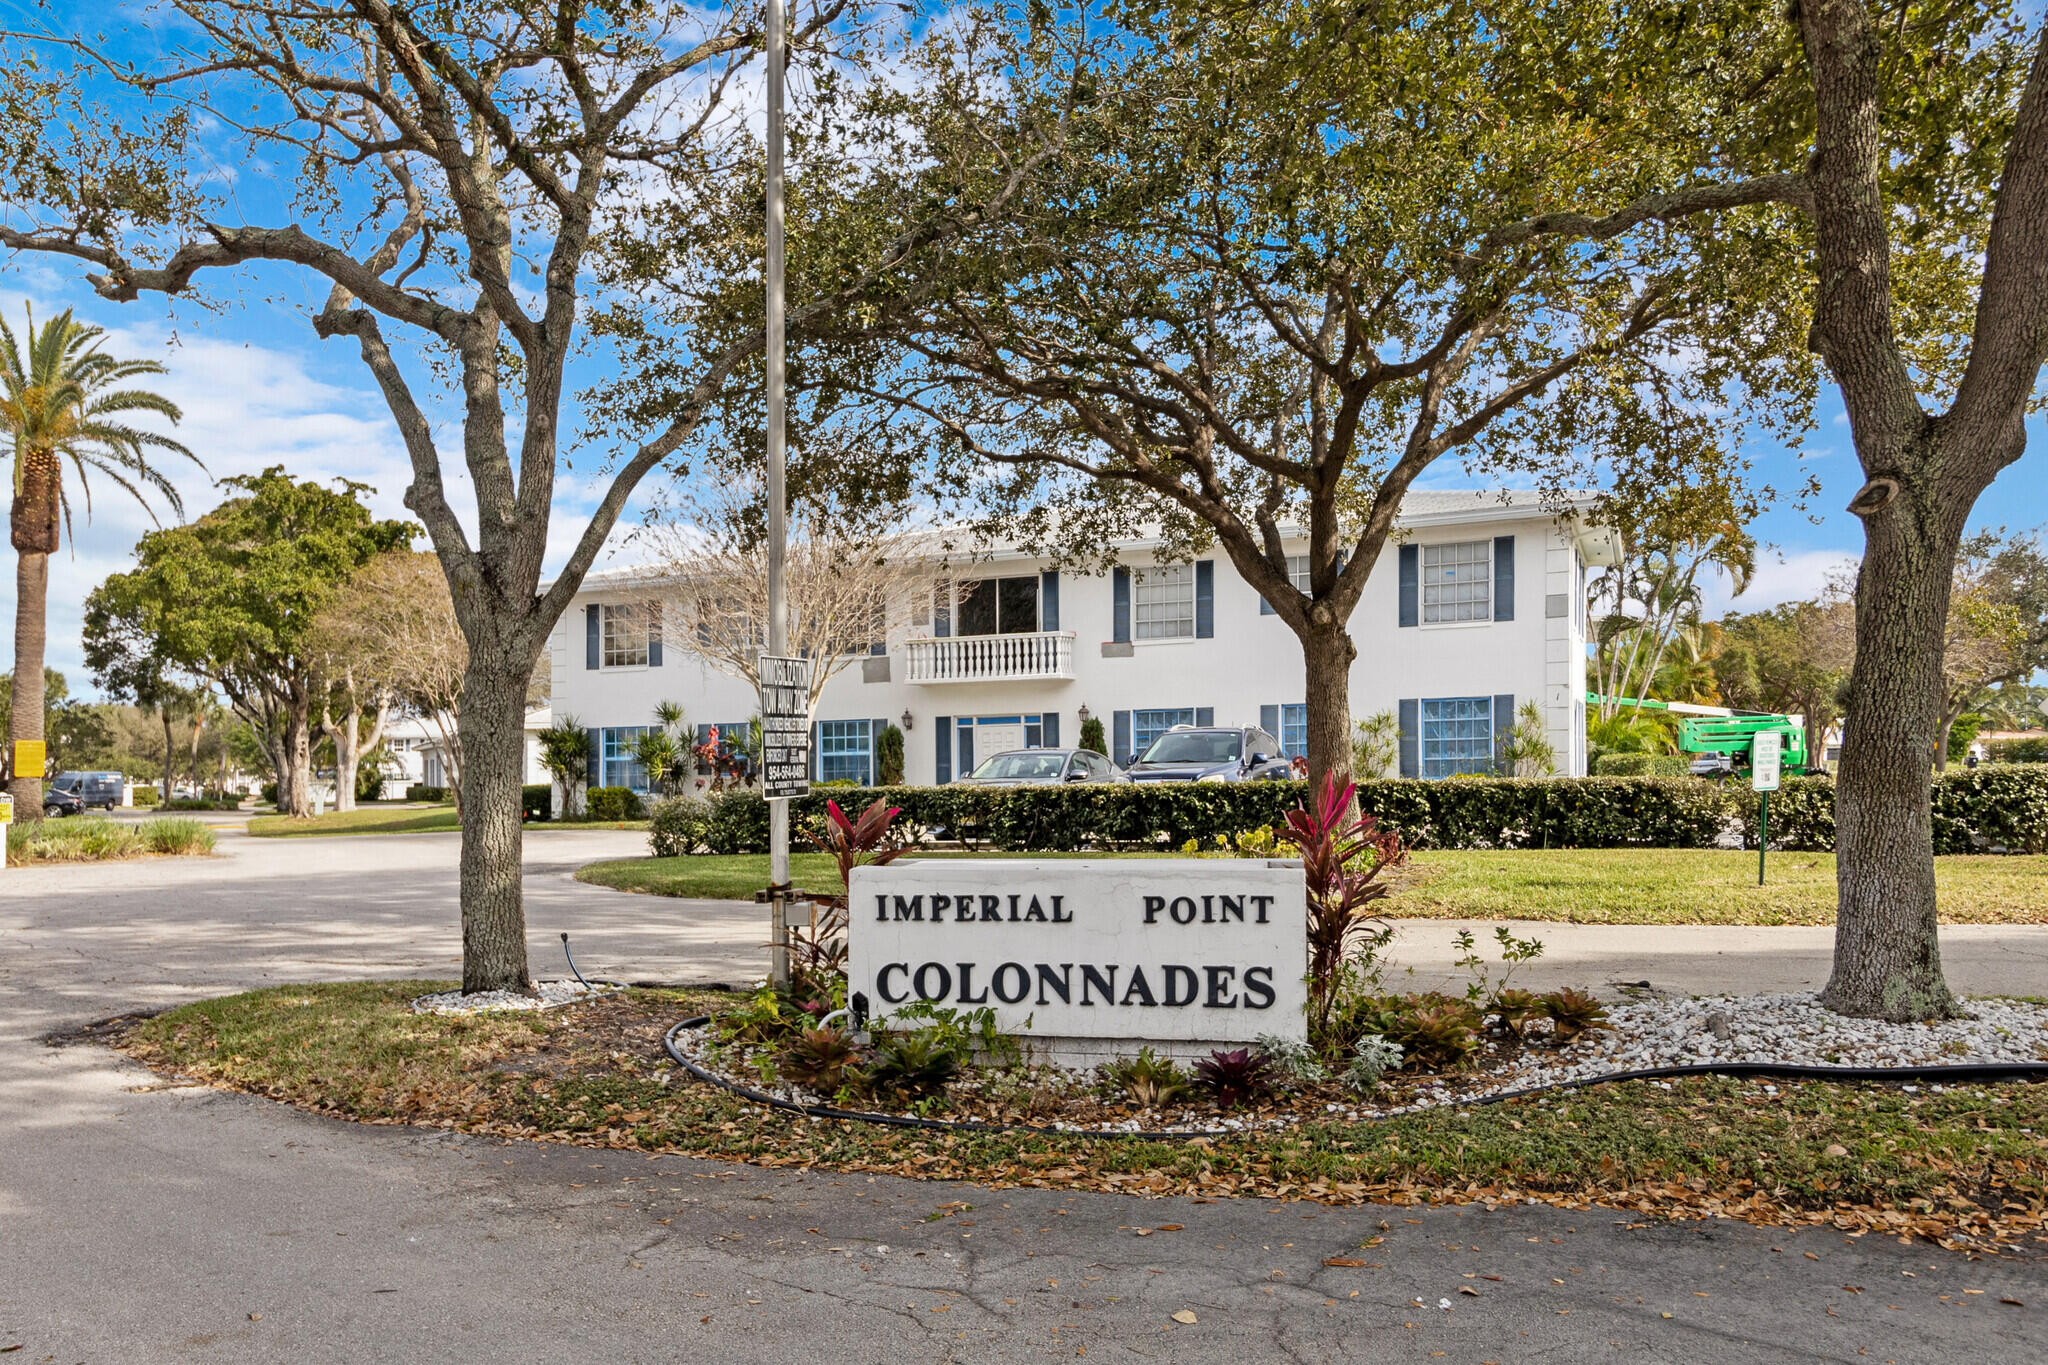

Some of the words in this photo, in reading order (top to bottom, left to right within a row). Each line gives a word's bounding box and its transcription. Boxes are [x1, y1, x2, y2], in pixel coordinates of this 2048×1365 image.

[761, 658, 808, 687] IMMOBILIZATION
[762, 688, 777, 714] TOW
[777, 688, 793, 714] AWAY
[794, 690, 808, 714] ZONE
[765, 781, 774, 790] ALL
[775, 780, 792, 789] COUNTY
[875, 894, 1074, 923] IMPERIAL
[1143, 895, 1275, 924] POINT
[875, 961, 1277, 1009] COLONNADES
